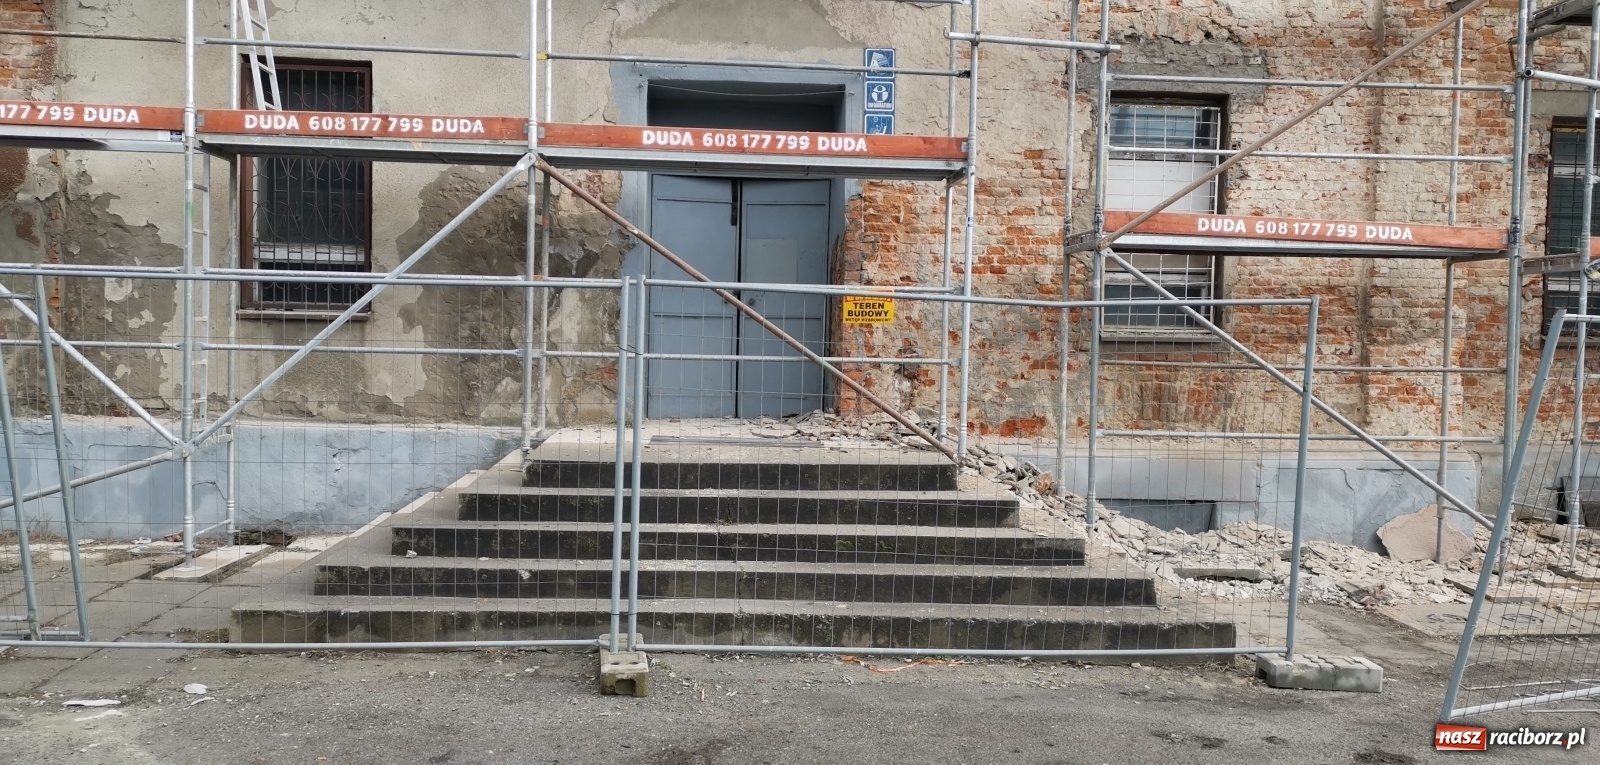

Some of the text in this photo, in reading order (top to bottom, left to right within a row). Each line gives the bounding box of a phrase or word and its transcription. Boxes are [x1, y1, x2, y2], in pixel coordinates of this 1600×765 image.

[37, 105, 75, 121] 799
[83, 106, 140, 123] DUDA
[244, 114, 485, 133] DUDA 608 177 799 DUDA
[642, 130, 867, 152] DUDA 608 177 799 DUDA
[1197, 217, 1413, 241] DUDA 608 177 799 DUDA
[853, 302, 885, 310] TEREN
